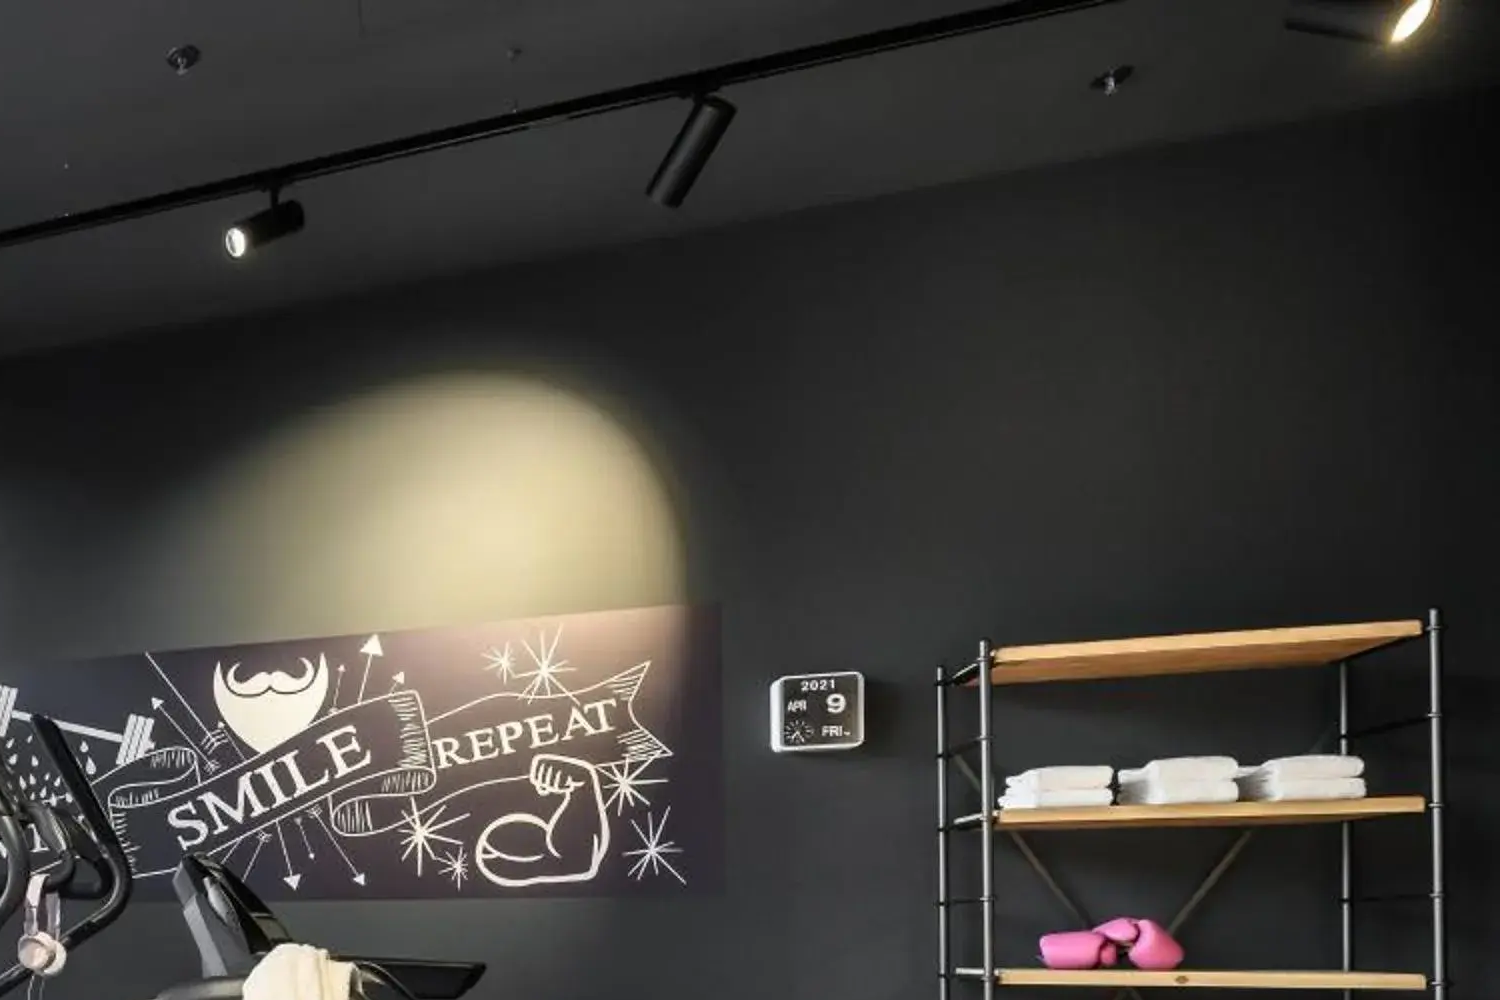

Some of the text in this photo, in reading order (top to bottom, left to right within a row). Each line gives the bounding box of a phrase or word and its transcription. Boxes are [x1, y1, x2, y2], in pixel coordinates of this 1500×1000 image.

[801, 679, 836, 692] 2021
[826, 693, 846, 714] 9
[431, 698, 618, 769] REPEAT
[167, 724, 372, 851] SMILE
